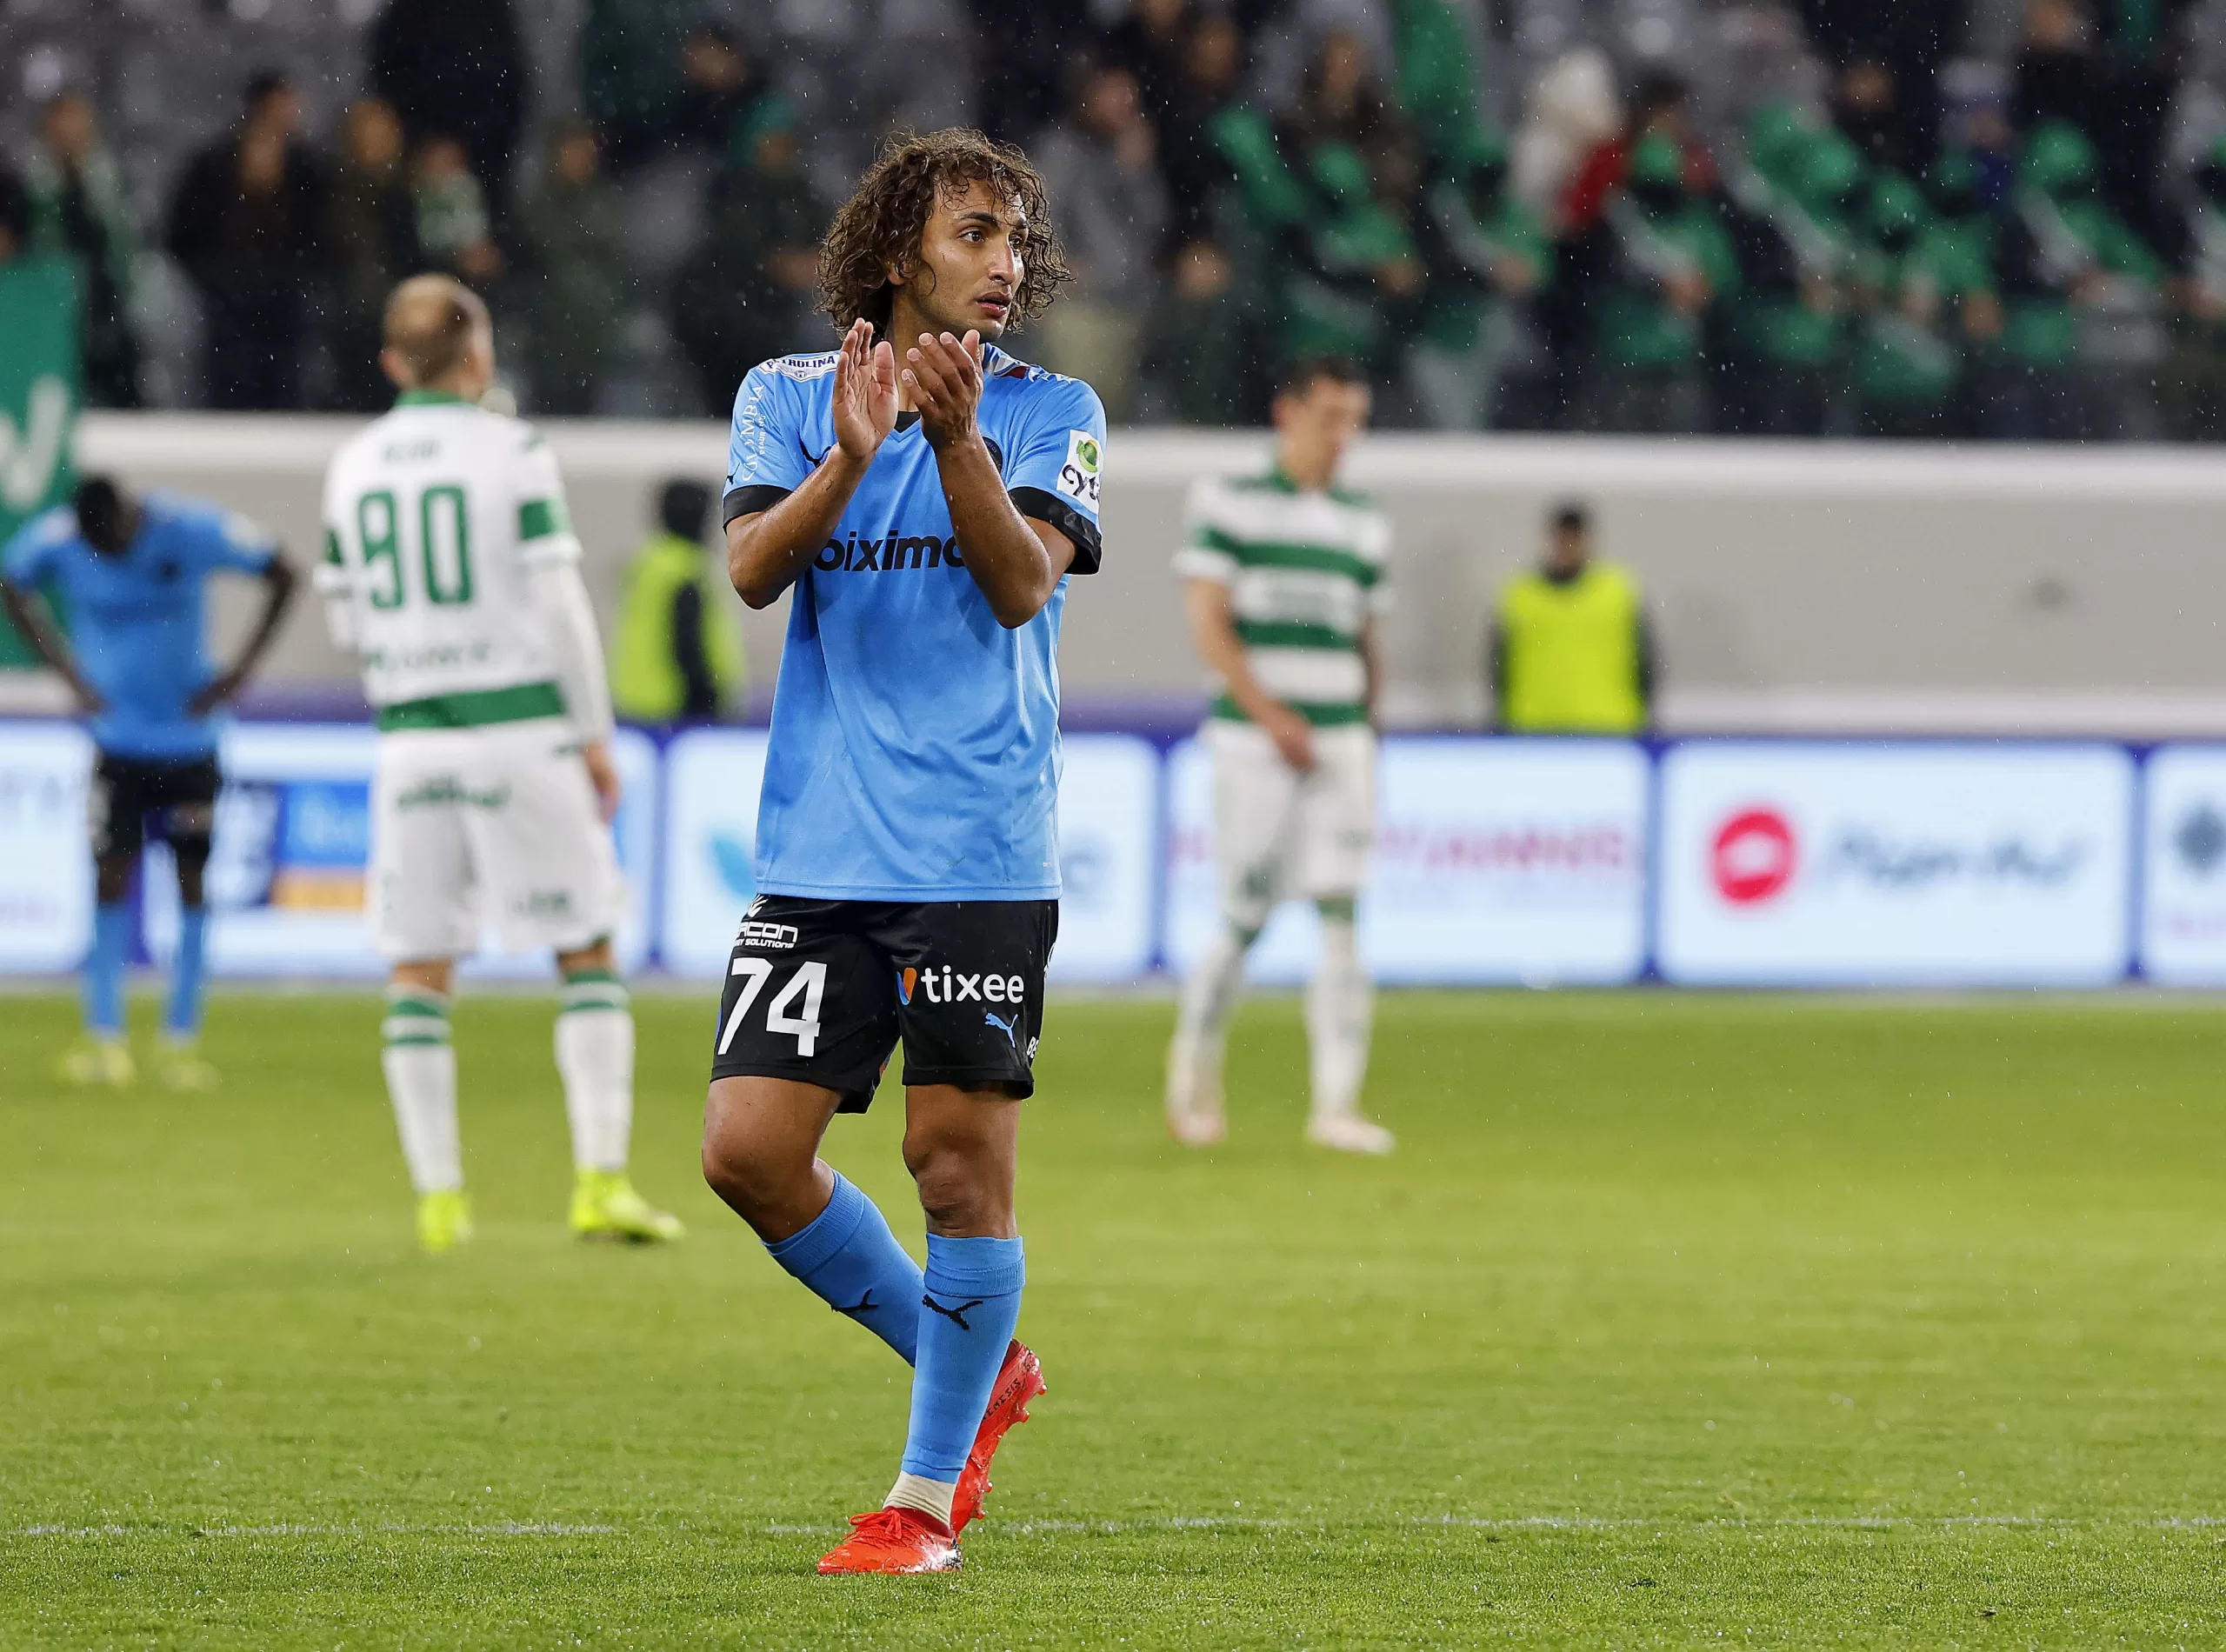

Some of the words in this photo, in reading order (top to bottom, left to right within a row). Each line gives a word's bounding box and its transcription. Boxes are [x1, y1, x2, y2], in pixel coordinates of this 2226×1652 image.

[357, 481, 472, 610] 90
[744, 938, 795, 949] SOLUTIONS
[717, 957, 827, 1057] 74
[920, 964, 1024, 1003] tixee
